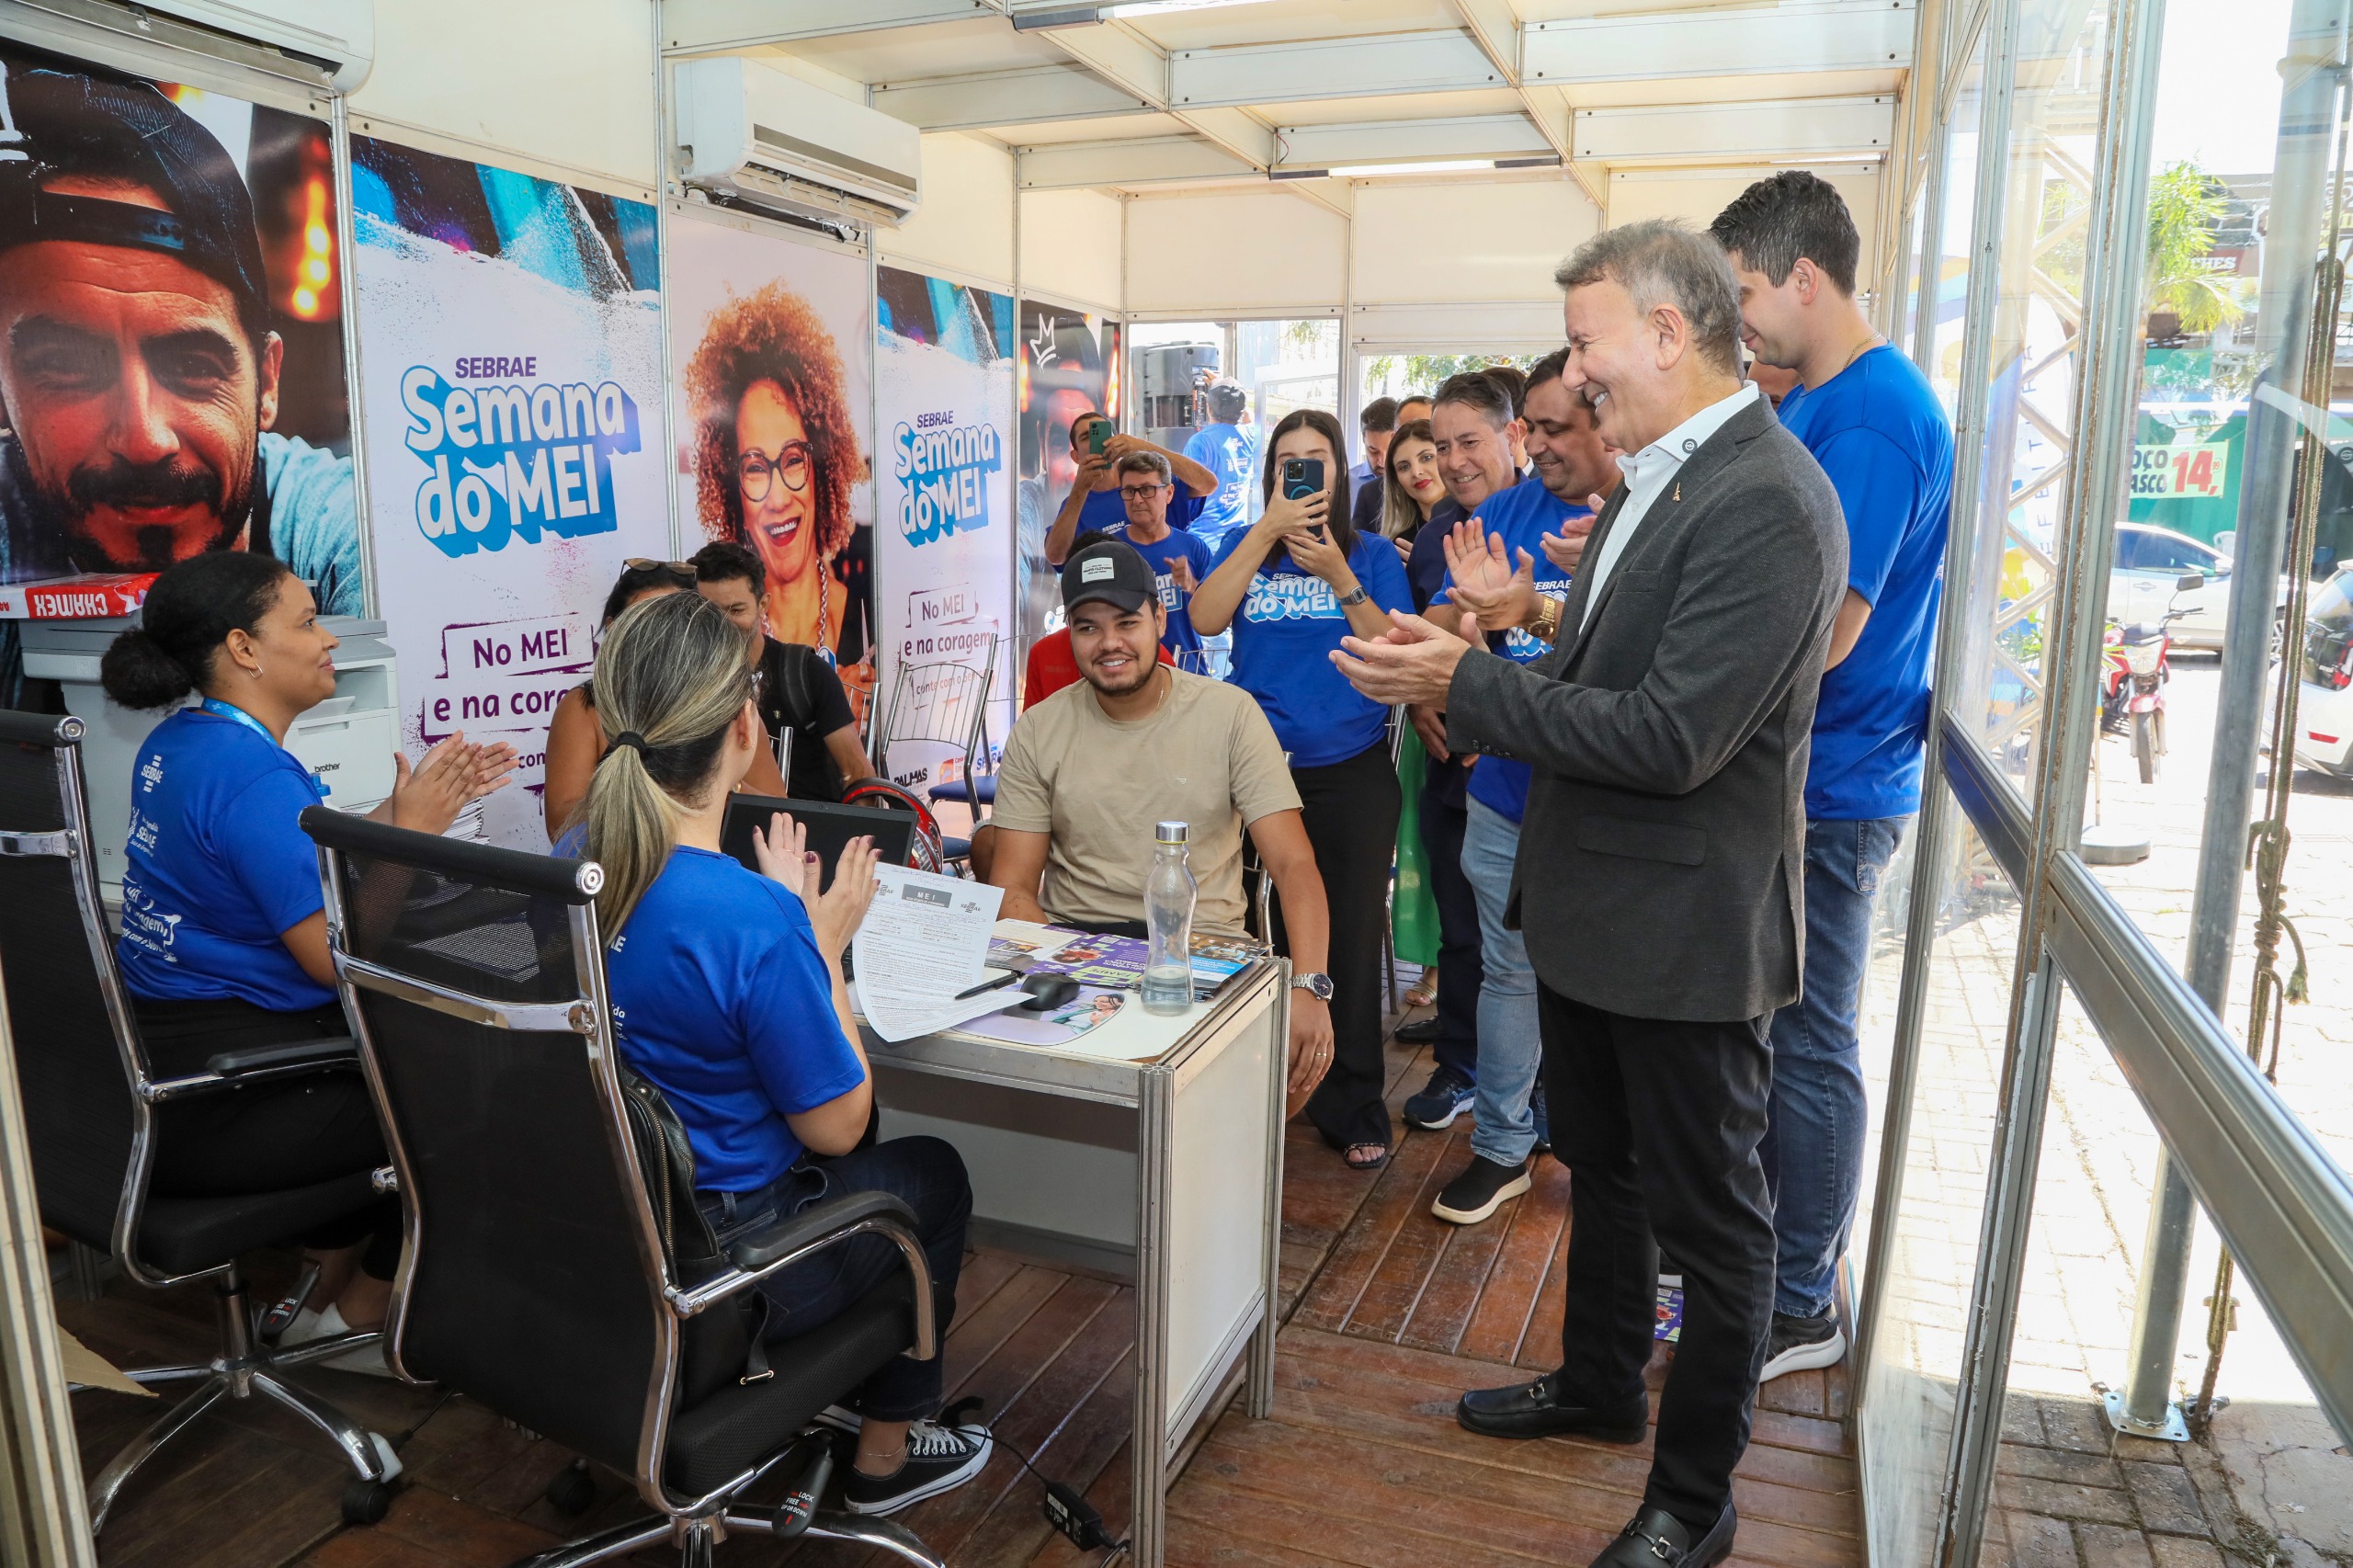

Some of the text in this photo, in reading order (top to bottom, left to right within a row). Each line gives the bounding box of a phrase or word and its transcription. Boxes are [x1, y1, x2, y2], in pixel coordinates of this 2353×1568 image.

[455, 357, 537, 378] SEBRAE
[402, 365, 626, 452] Semana
[916, 410, 953, 428] SEBRAE
[893, 421, 995, 478] Semana
[416, 443, 601, 540] do MEI
[900, 467, 982, 536] do MEI
[1102, 520, 1125, 533] SEBRAE
[33, 593, 108, 618] CHAMEX
[922, 594, 964, 620] No MEI
[1245, 591, 1336, 617] do MEI
[472, 628, 568, 669] No MEI
[904, 631, 991, 656] e na coragem
[434, 694, 450, 722] e
[462, 692, 500, 720] na
[141, 764, 164, 784] SEBRAE
[314, 763, 340, 772] brother
[894, 767, 928, 788] PALMAS
[786, 1497, 800, 1506] FREE
[798, 1491, 814, 1503] LOCK
[792, 1506, 808, 1518] DOWN
